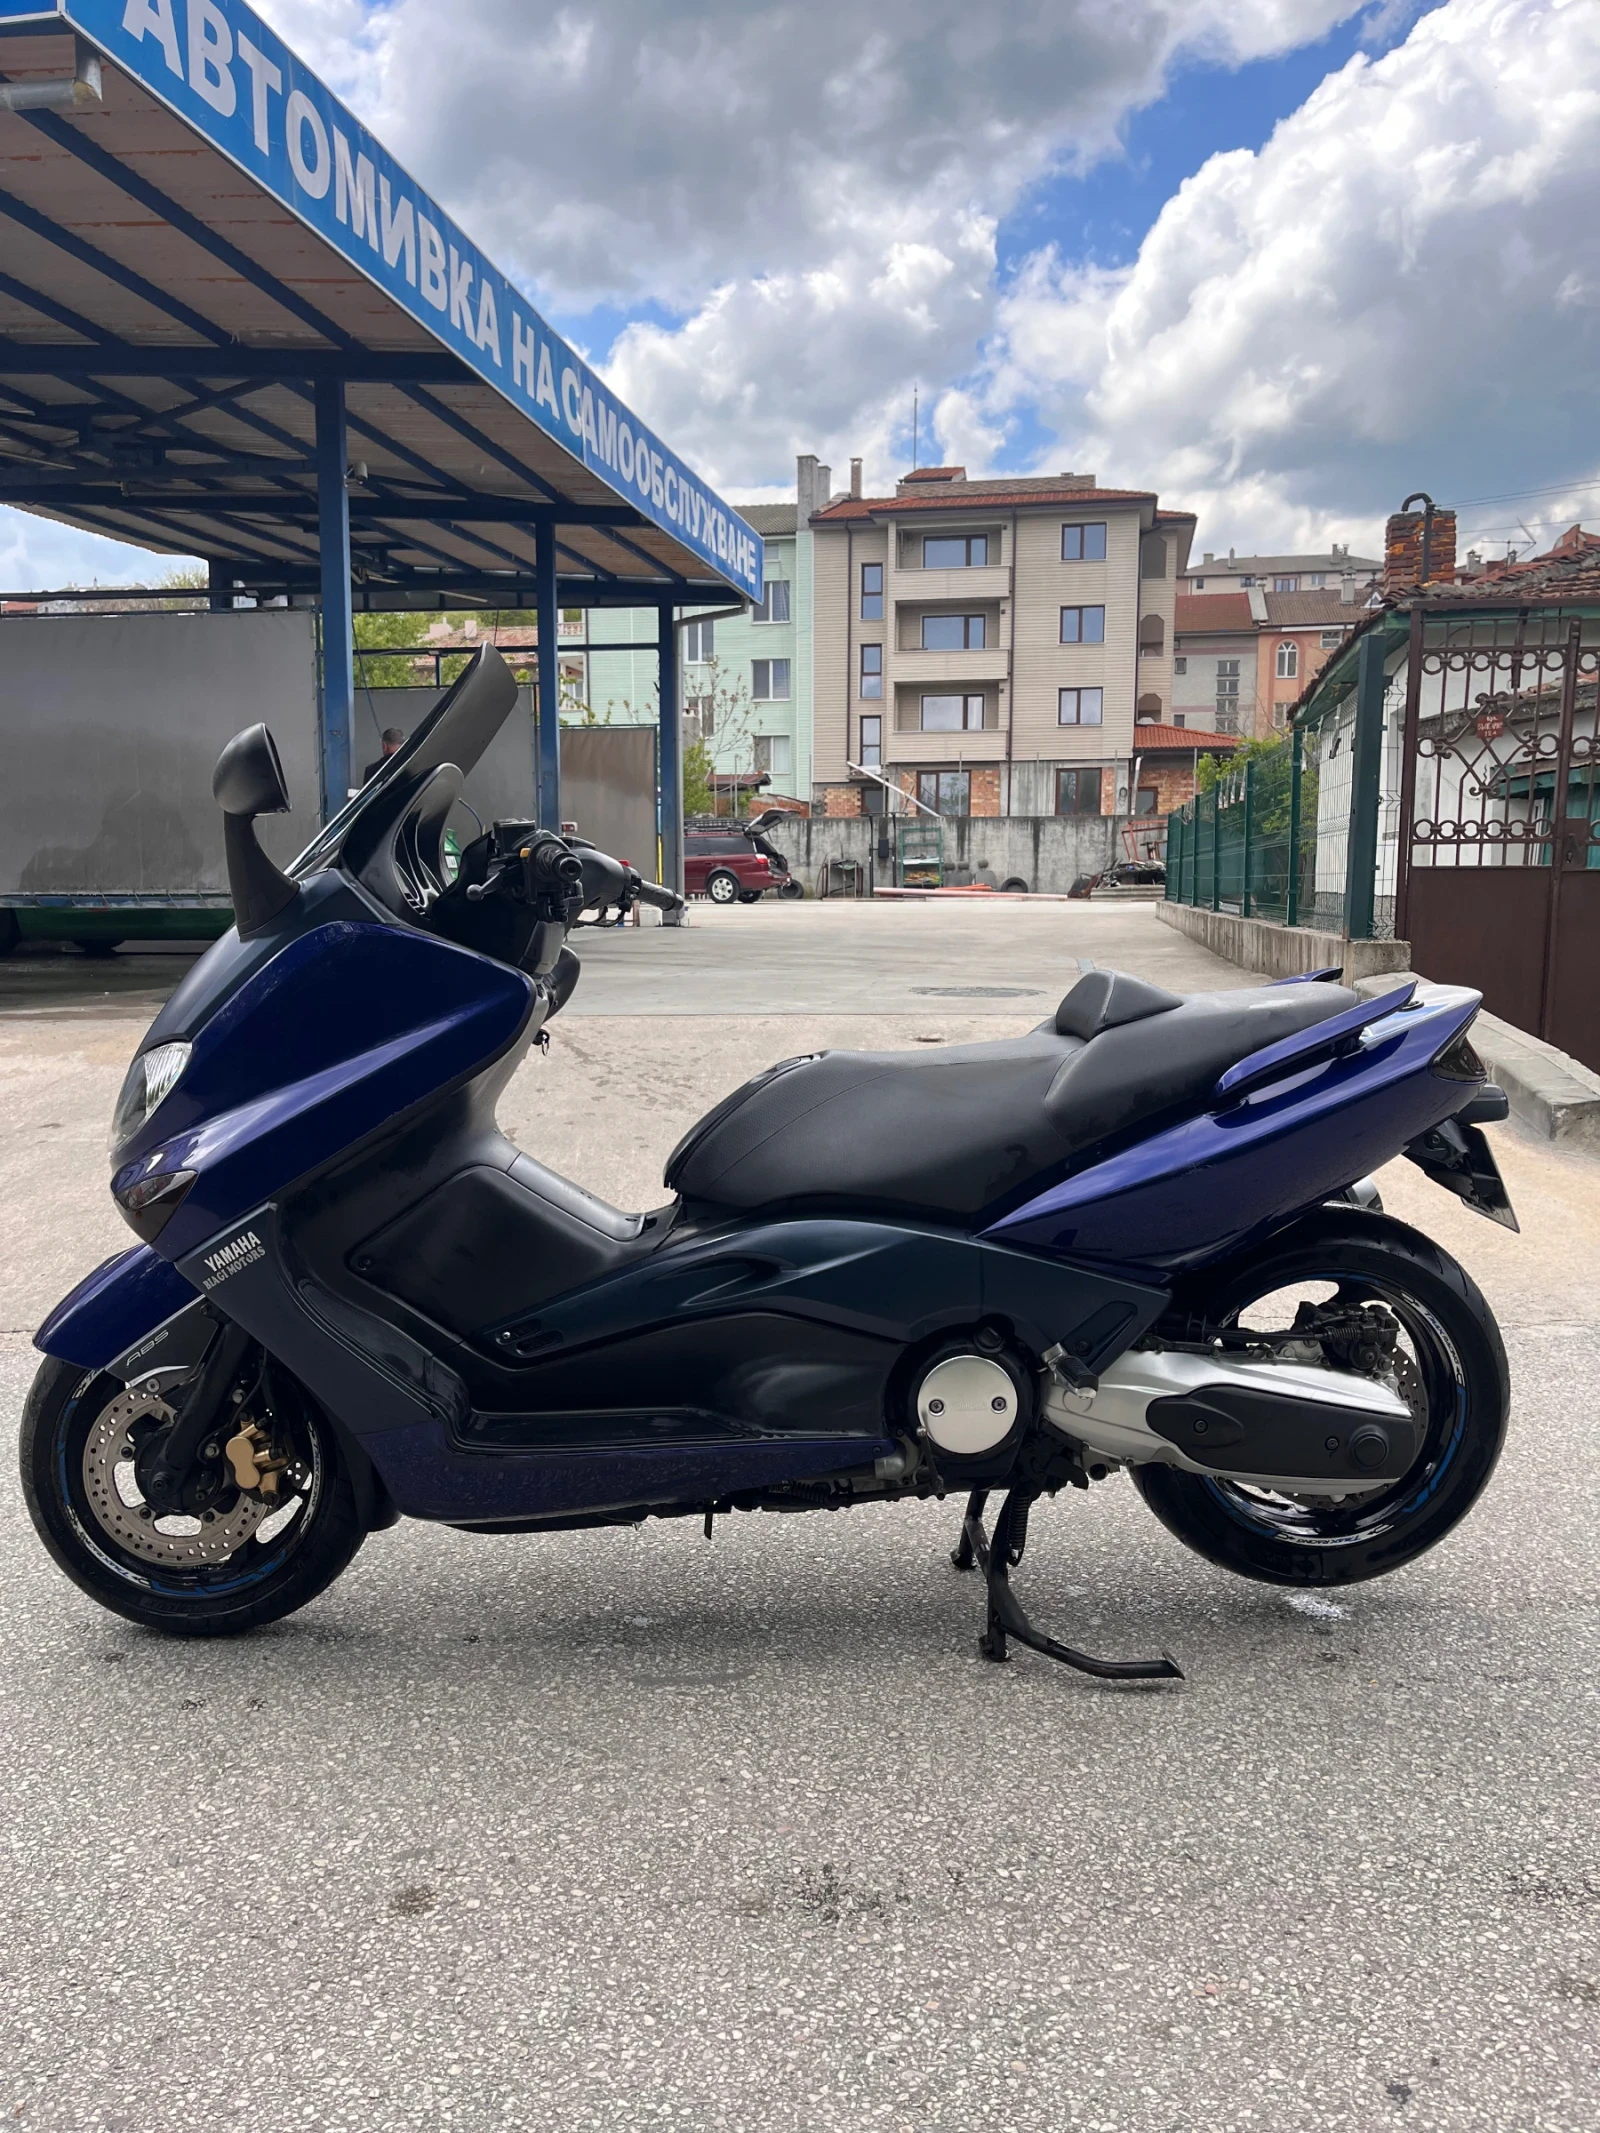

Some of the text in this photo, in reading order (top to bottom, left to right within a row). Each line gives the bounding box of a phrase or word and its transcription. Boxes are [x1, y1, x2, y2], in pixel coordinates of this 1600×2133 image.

[122, 0, 756, 585] АВТОМИВКА НА САМООБСЛУЖВАНЕ
[202, 1245, 266, 1290] BIAGI MOTORS
[204, 1231, 261, 1272] YAMAHA
[126, 1329, 169, 1366] ABS
